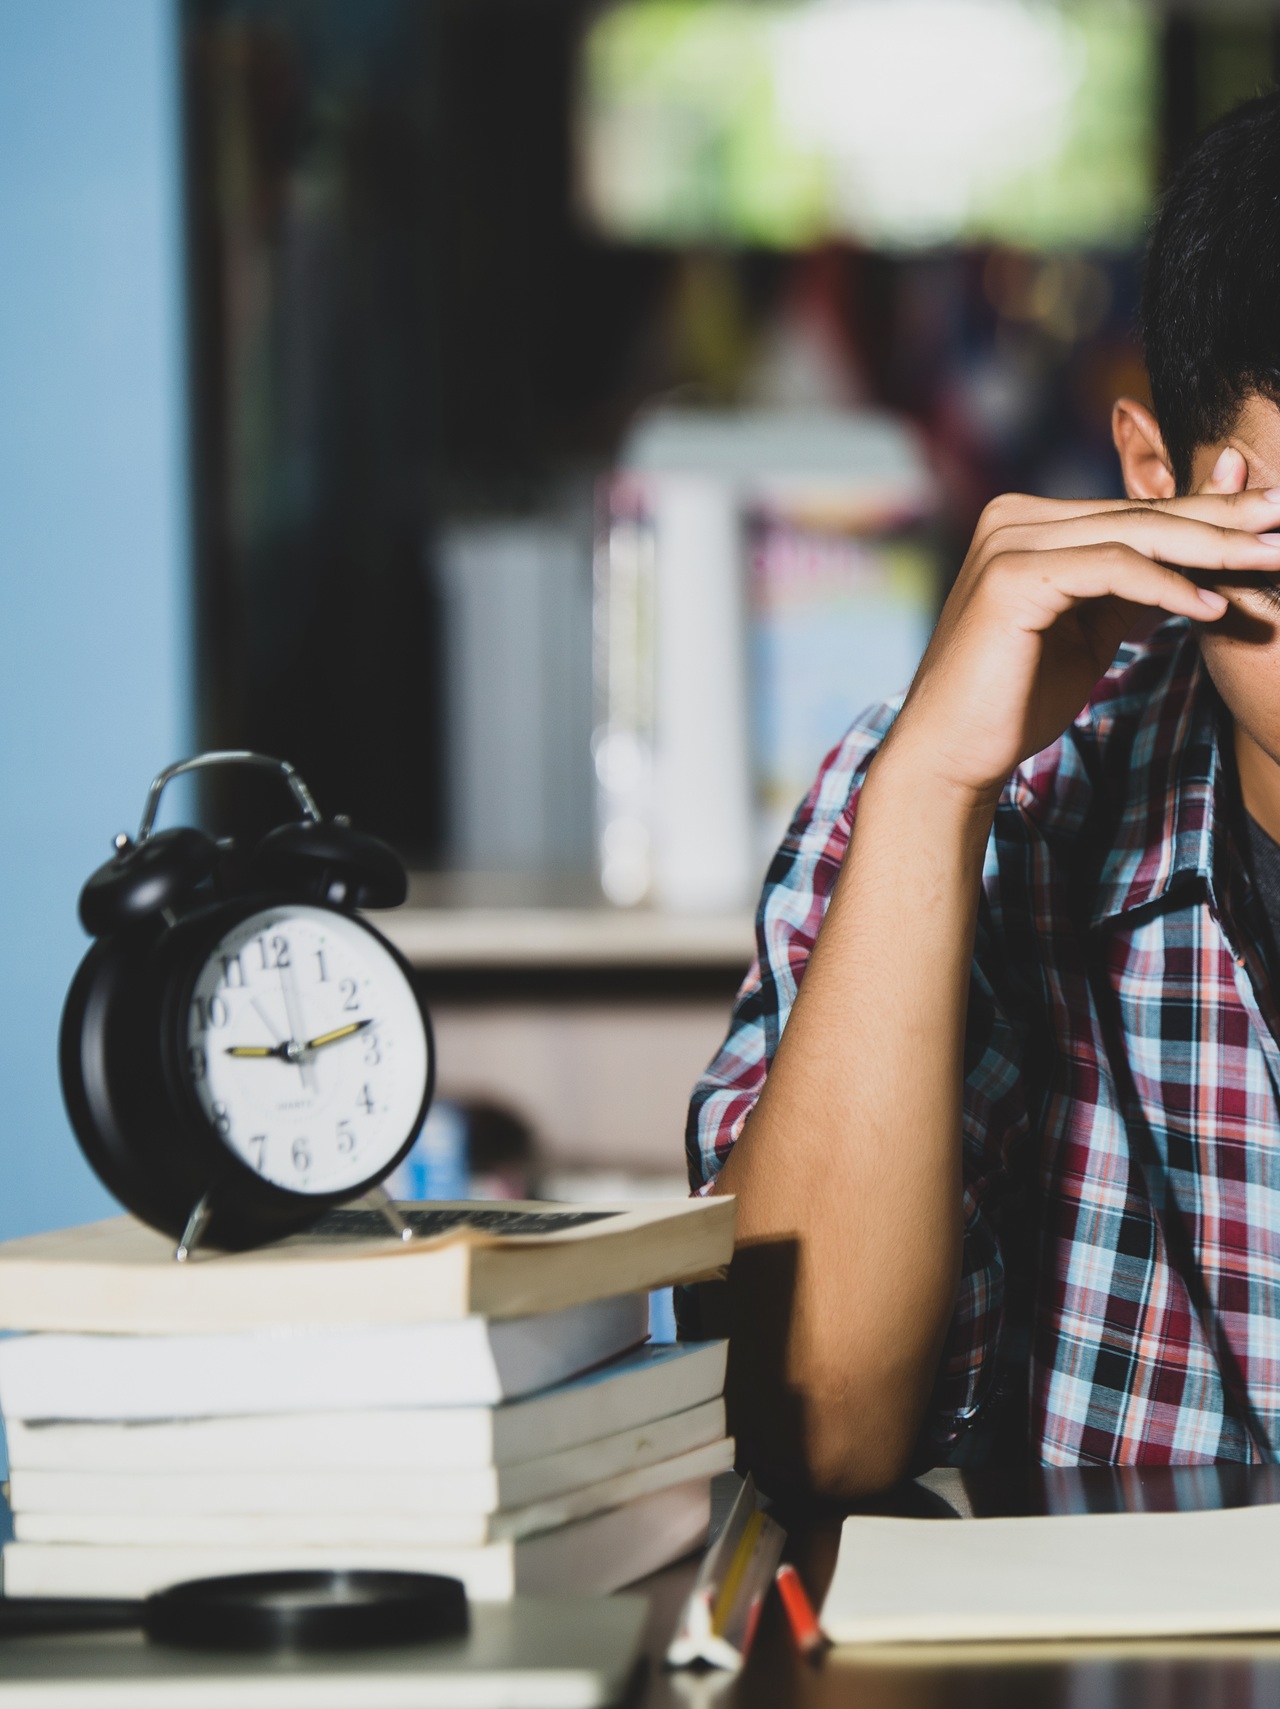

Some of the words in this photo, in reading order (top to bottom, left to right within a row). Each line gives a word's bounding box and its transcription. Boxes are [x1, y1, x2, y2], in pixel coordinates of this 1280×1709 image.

[258, 935, 291, 970] 12
[315, 950, 329, 982] 1
[221, 954, 247, 988] 11
[339, 978, 359, 1011] 2
[193, 996, 229, 1031] 10
[361, 1032, 381, 1066] 3
[356, 1083, 374, 1115] 4
[211, 1101, 230, 1134] 8
[251, 1135, 266, 1170] 7
[337, 1120, 354, 1152] 5
[291, 1137, 309, 1172] 6
